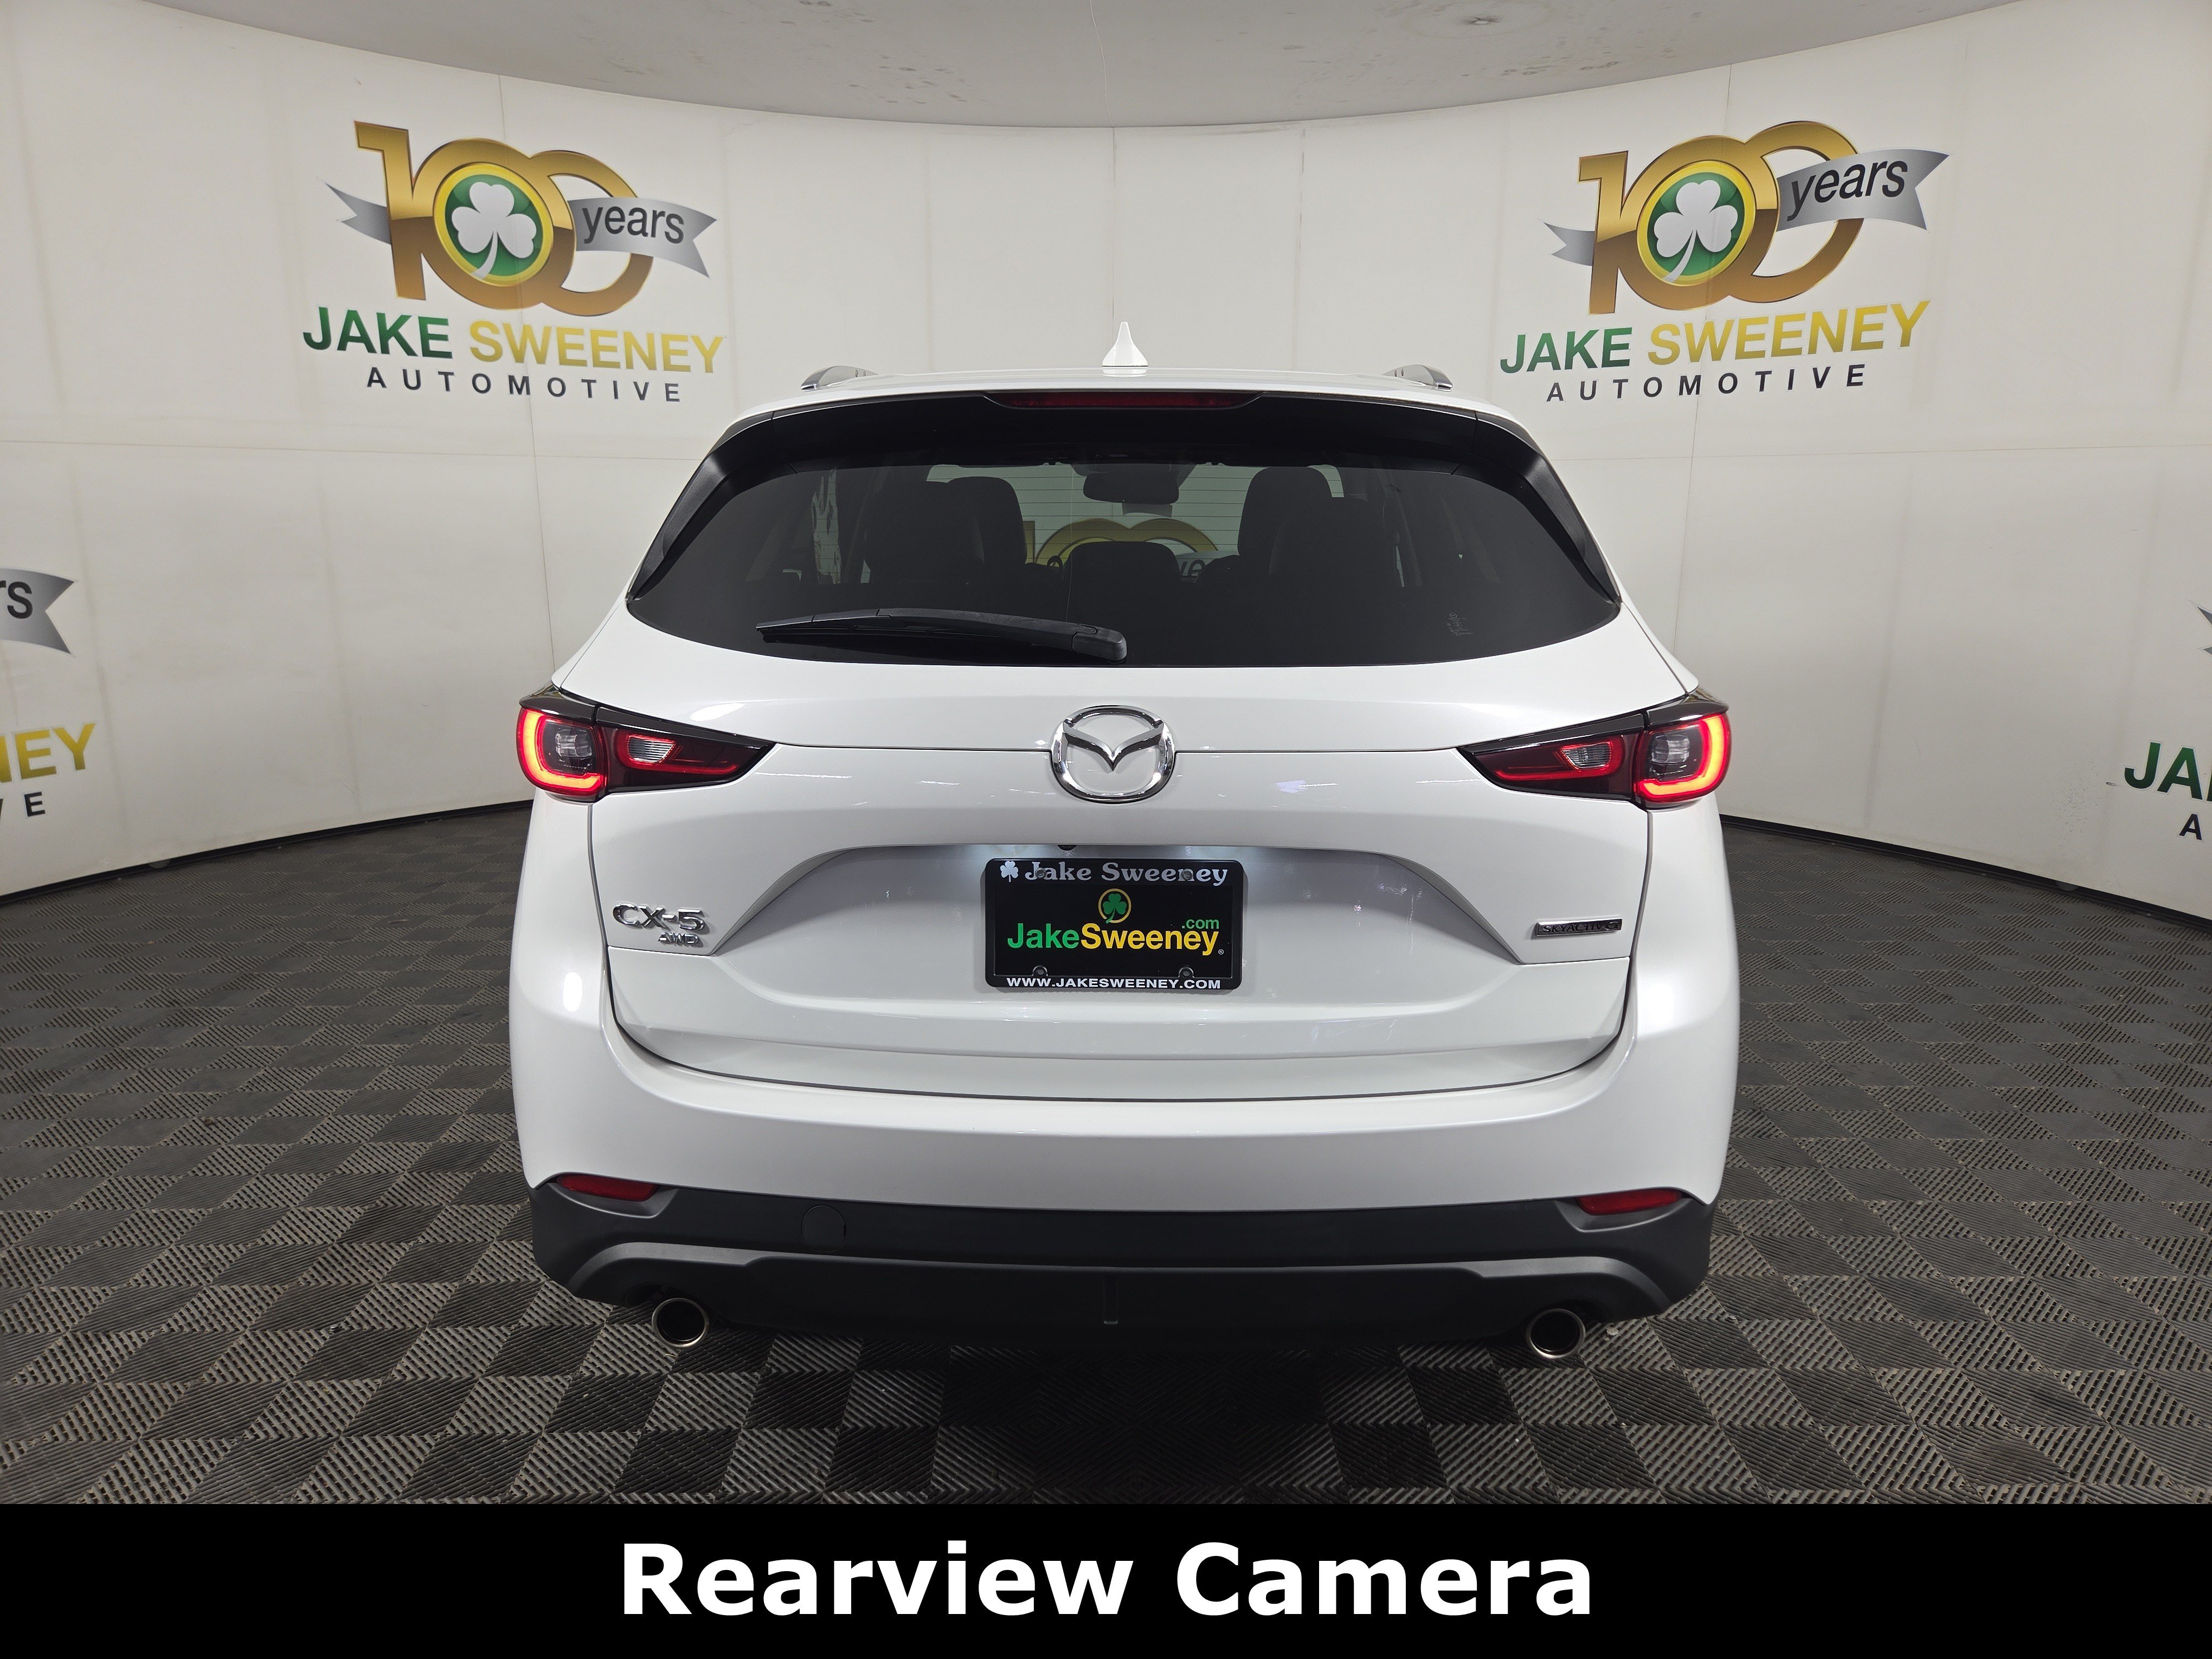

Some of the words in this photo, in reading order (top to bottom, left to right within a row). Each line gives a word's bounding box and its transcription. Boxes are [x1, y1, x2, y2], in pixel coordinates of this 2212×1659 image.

[1787, 160, 1908, 221] years
[583, 206, 685, 244] years
[303, 306, 453, 359] JAKE
[470, 320, 724, 373] SWEENEY
[1500, 327, 1632, 374] JAKE
[1648, 300, 1931, 365] SWEENEY
[366, 366, 680, 402] AUTOMOTIVE
[1547, 364, 1866, 402] AUTOMOTIVE
[1025, 861, 1092, 881] Jake
[1102, 862, 1227, 886] Sweeney
[613, 903, 705, 931] CX-5
[658, 932, 699, 944] AWD
[1007, 978, 1221, 989] WWW.JAKESWEENEY.COM
